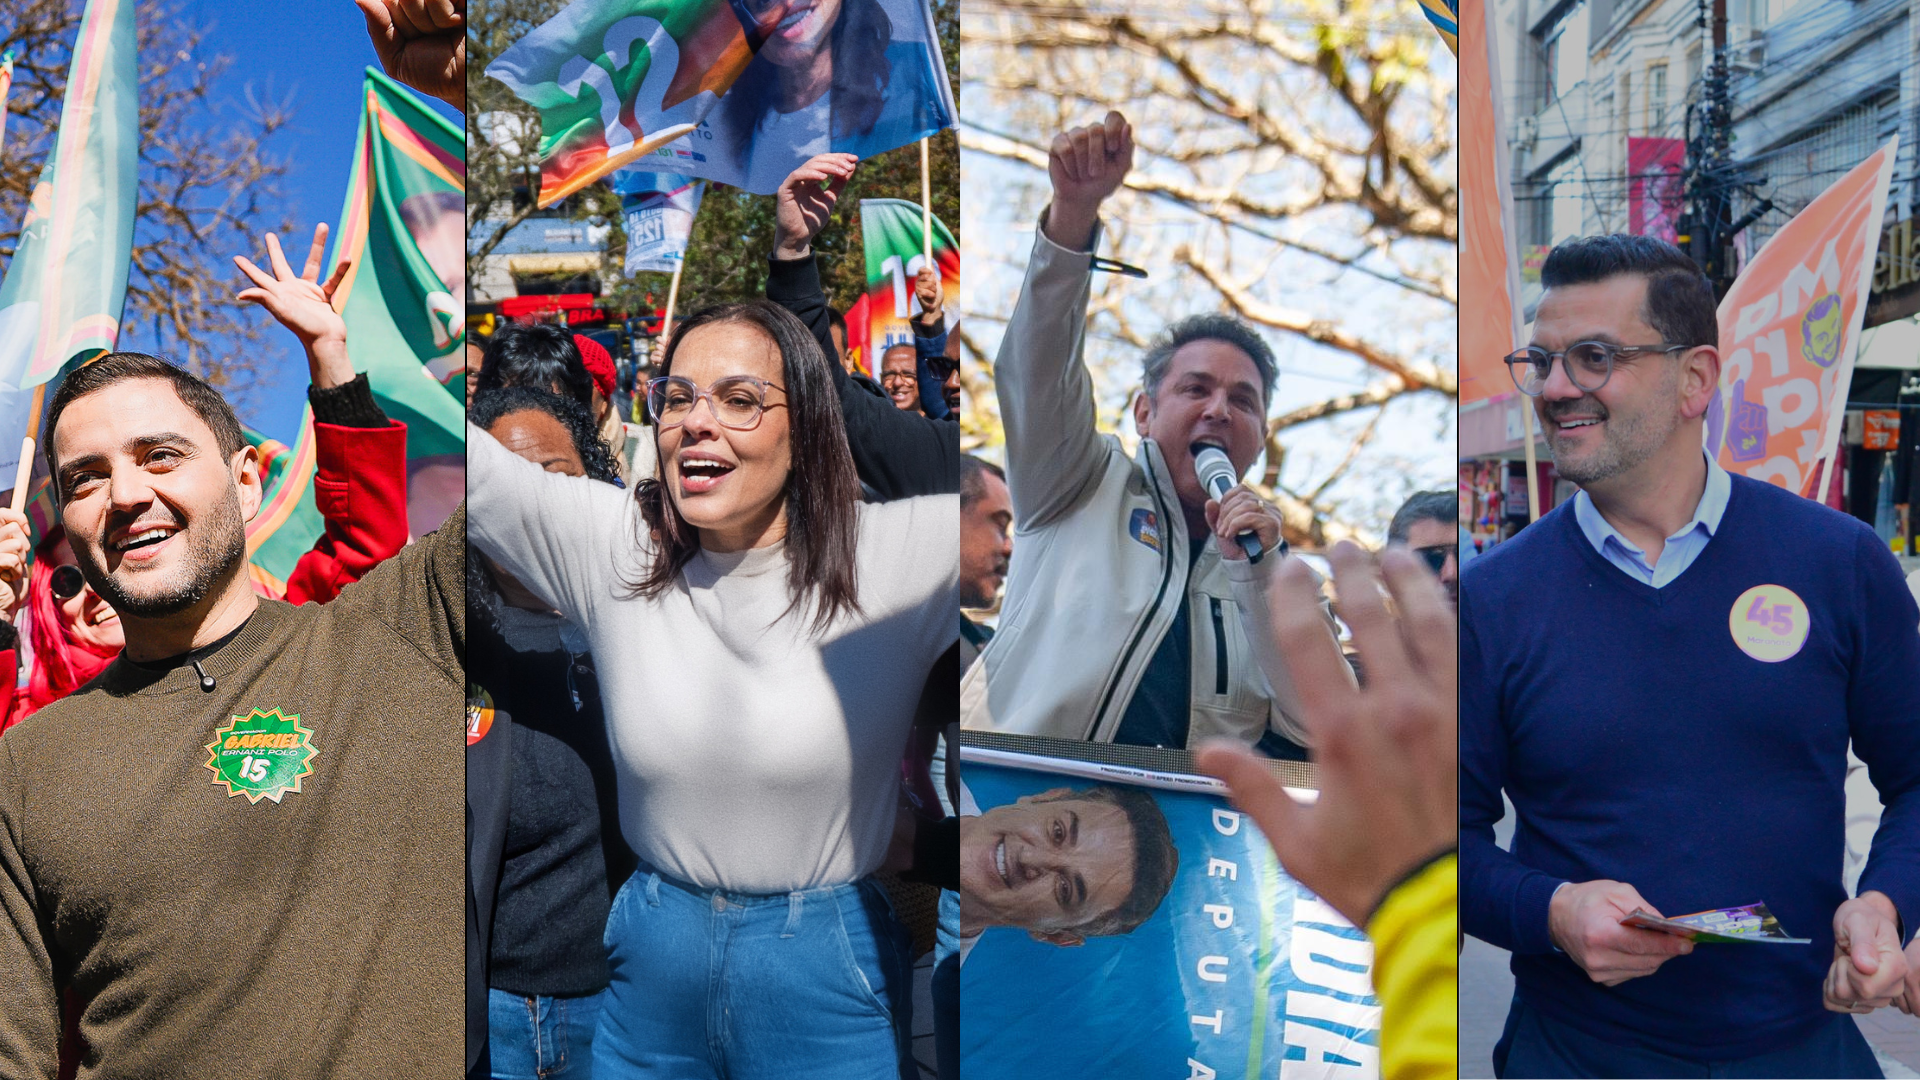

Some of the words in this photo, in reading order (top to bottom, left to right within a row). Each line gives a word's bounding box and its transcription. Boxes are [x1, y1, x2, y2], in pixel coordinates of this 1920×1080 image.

[558, 15, 718, 158] 12
[1746, 595, 1794, 636] 45
[223, 733, 302, 750] GABRIEL
[239, 755, 272, 783] 15
